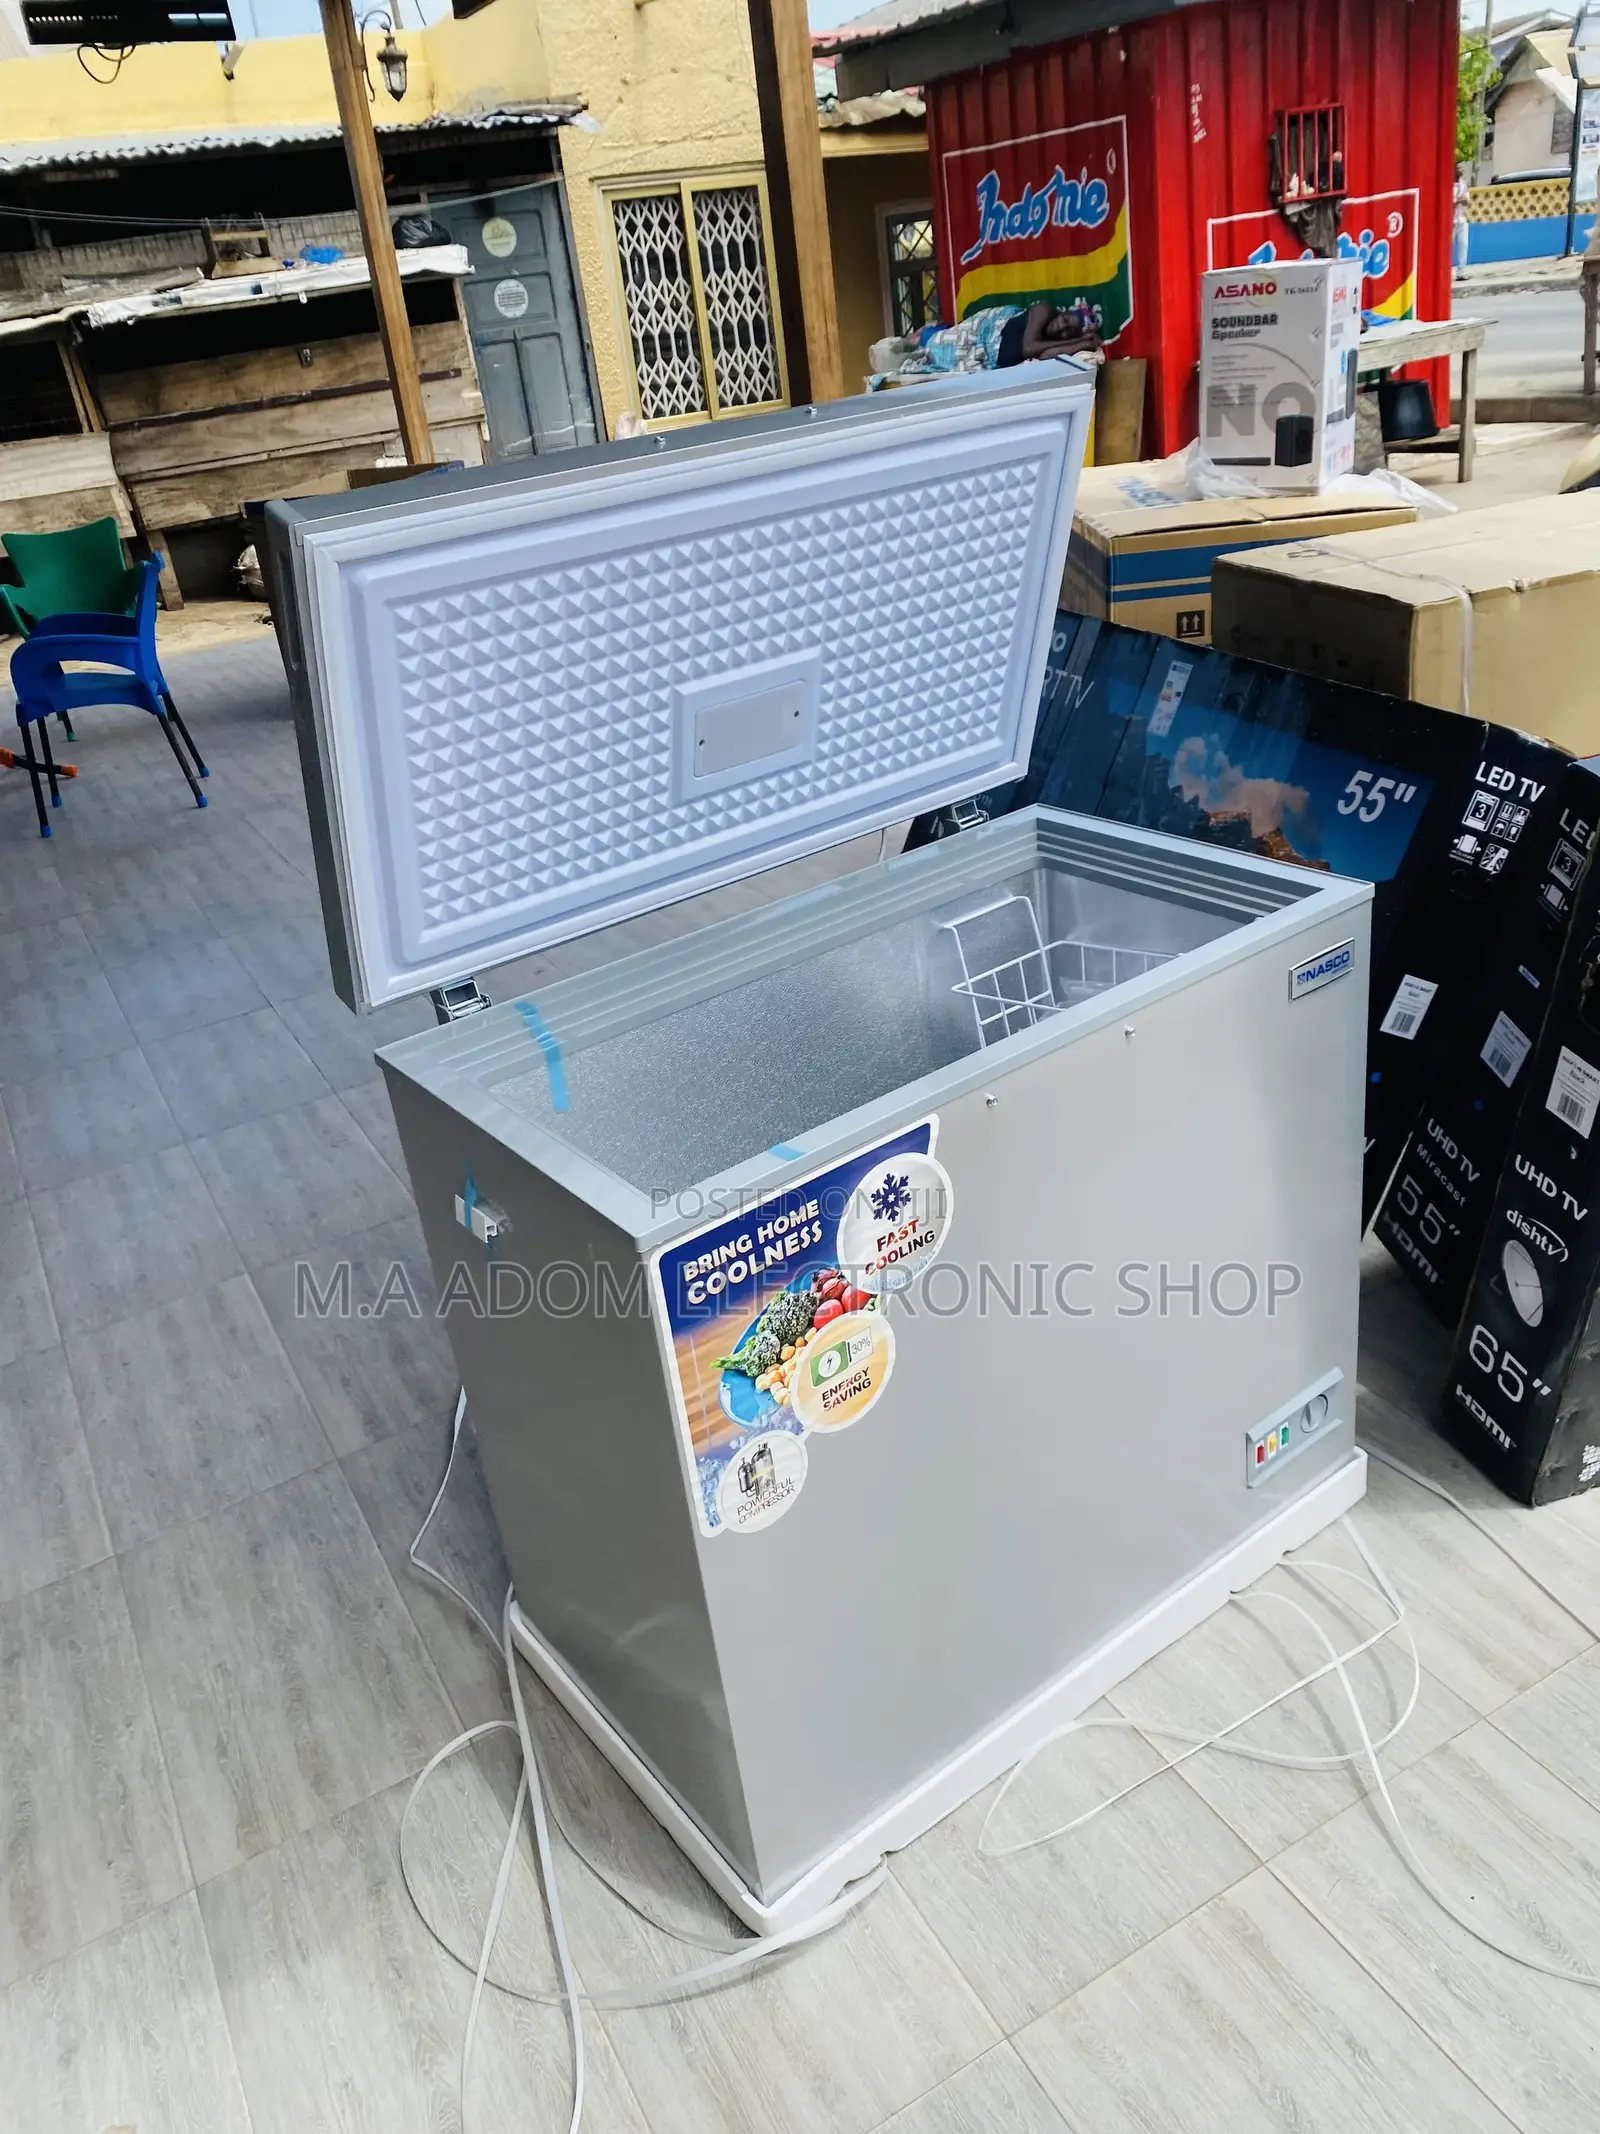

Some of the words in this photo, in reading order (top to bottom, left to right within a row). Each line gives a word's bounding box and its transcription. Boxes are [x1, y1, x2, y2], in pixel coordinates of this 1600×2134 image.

[961, 164, 1109, 265] Indomie
[1214, 282, 1278, 299] ASANO
[1211, 312, 1279, 329] SOUNDBAR
[1211, 328, 1261, 342] Speaker
[1065, 674, 1095, 709] TV
[1337, 769, 1418, 823] 55"
[1474, 761, 1517, 792] LED
[1518, 776, 1546, 803] TV
[1474, 803, 1488, 819] 3
[1560, 856, 1573, 873] 3
[1305, 950, 1351, 983] NASCO
[1427, 1117, 1459, 1160] UHD
[1460, 1153, 1481, 1183] TV
[1415, 1143, 1466, 1207] Miracast
[1515, 1154, 1558, 1198] UHD
[1561, 1190, 1589, 1221] TV
[683, 1234, 752, 1282] BRING
[757, 1199, 820, 1244] HOME
[865, 1231, 935, 1276] COOLING
[876, 1218, 920, 1252] FAST
[1506, 1209, 1569, 1262] dishtv
[687, 1220, 823, 1304] COOLNESS
[851, 1335, 871, 1355] 30%
[822, 1367, 870, 1401] ENERGY
[823, 1378, 872, 1412] SAVING
[1456, 1384, 1512, 1449] HDMI
[737, 1476, 796, 1516] POWERFUL
[739, 1485, 796, 1524] COMPRESSOR
